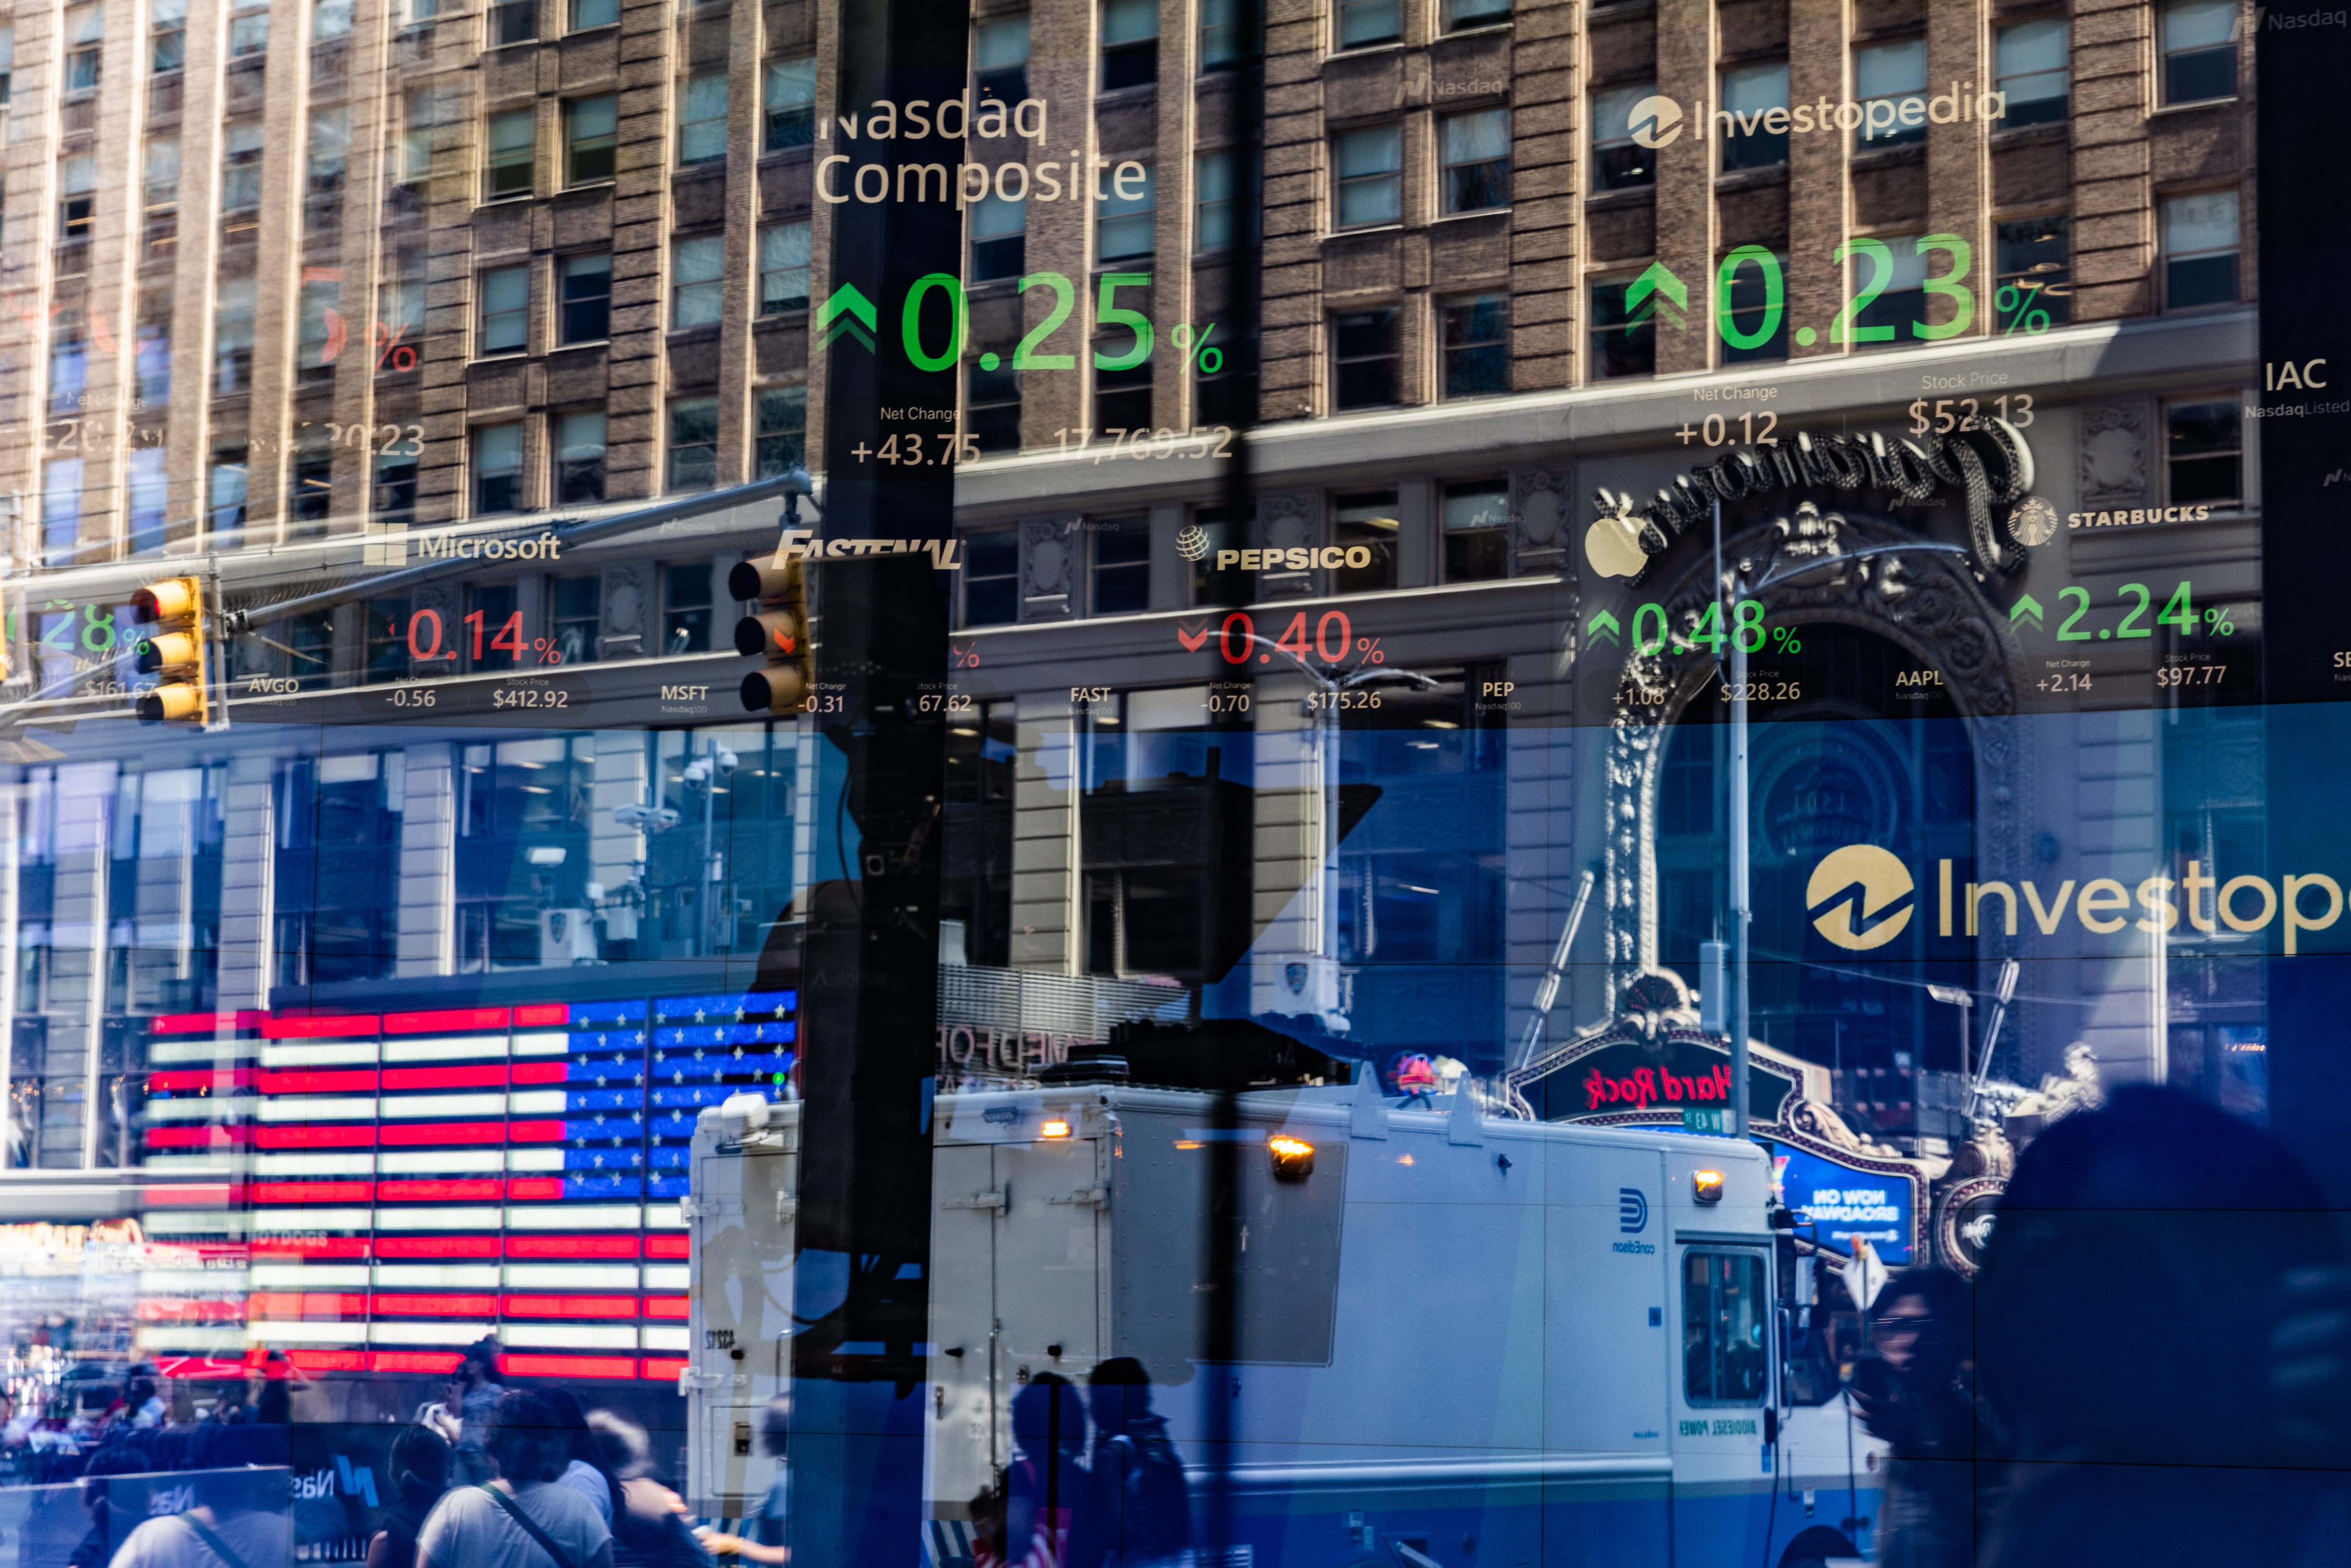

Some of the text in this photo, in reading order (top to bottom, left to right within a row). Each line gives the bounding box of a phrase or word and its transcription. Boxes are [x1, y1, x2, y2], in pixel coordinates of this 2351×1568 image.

[2268, 8, 2347, 31] Nasdaq
[1433, 78, 1504, 97] Nasdaq
[1694, 80, 2007, 141] Investopedia
[816, 149, 1147, 211] Composite
[1922, 371, 2008, 390] Stock Price
[2265, 358, 2327, 392] IAC
[1693, 386, 1778, 401] Net Change
[880, 407, 961, 423] Net Change
[1909, 394, 2034, 439] $5213
[2244, 400, 2350, 419] NasdaqListed
[1675, 411, 1778, 447] +0.12
[851, 433, 981, 466] +43.75
[1054, 426, 1233, 465] 17,769.52
[1907, 497, 1946, 509] Nasdaq
[1489, 512, 1526, 524] Nasdaq
[2068, 505, 2210, 528] STARBUCKS
[1082, 521, 1119, 533] Nasdaq
[419, 531, 561, 560] Microsoft
[1217, 546, 1371, 571] PEPSICO
[2060, 659, 2090, 667] Change
[2165, 652, 2211, 663] Stock Price
[507, 677, 549, 686] Stock Price
[1758, 669, 1779, 677] Price
[1896, 671, 1944, 686] AAPL
[2157, 665, 2227, 688] $97.77
[248, 678, 299, 693] AVGO
[819, 683, 847, 691] Change
[1224, 682, 1251, 690] Change
[1483, 682, 1515, 697] PEP
[1721, 682, 1801, 702] $228.26
[2036, 673, 2092, 693] +2.14
[385, 689, 436, 707] -0.56
[493, 689, 568, 709] $412.92
[661, 685, 709, 701] MSFT
[1070, 687, 1112, 702] FAST
[1307, 691, 1382, 712] $175.26
[1612, 687, 1665, 705] +1.08
[661, 704, 708, 715] Nasdaq100
[798, 695, 844, 713] -0.31
[919, 694, 972, 712] 67.62
[1201, 694, 1250, 713] -0.70
[1475, 701, 1522, 711] Nasdaq100
[1939, 858, 2351, 957] Investop
